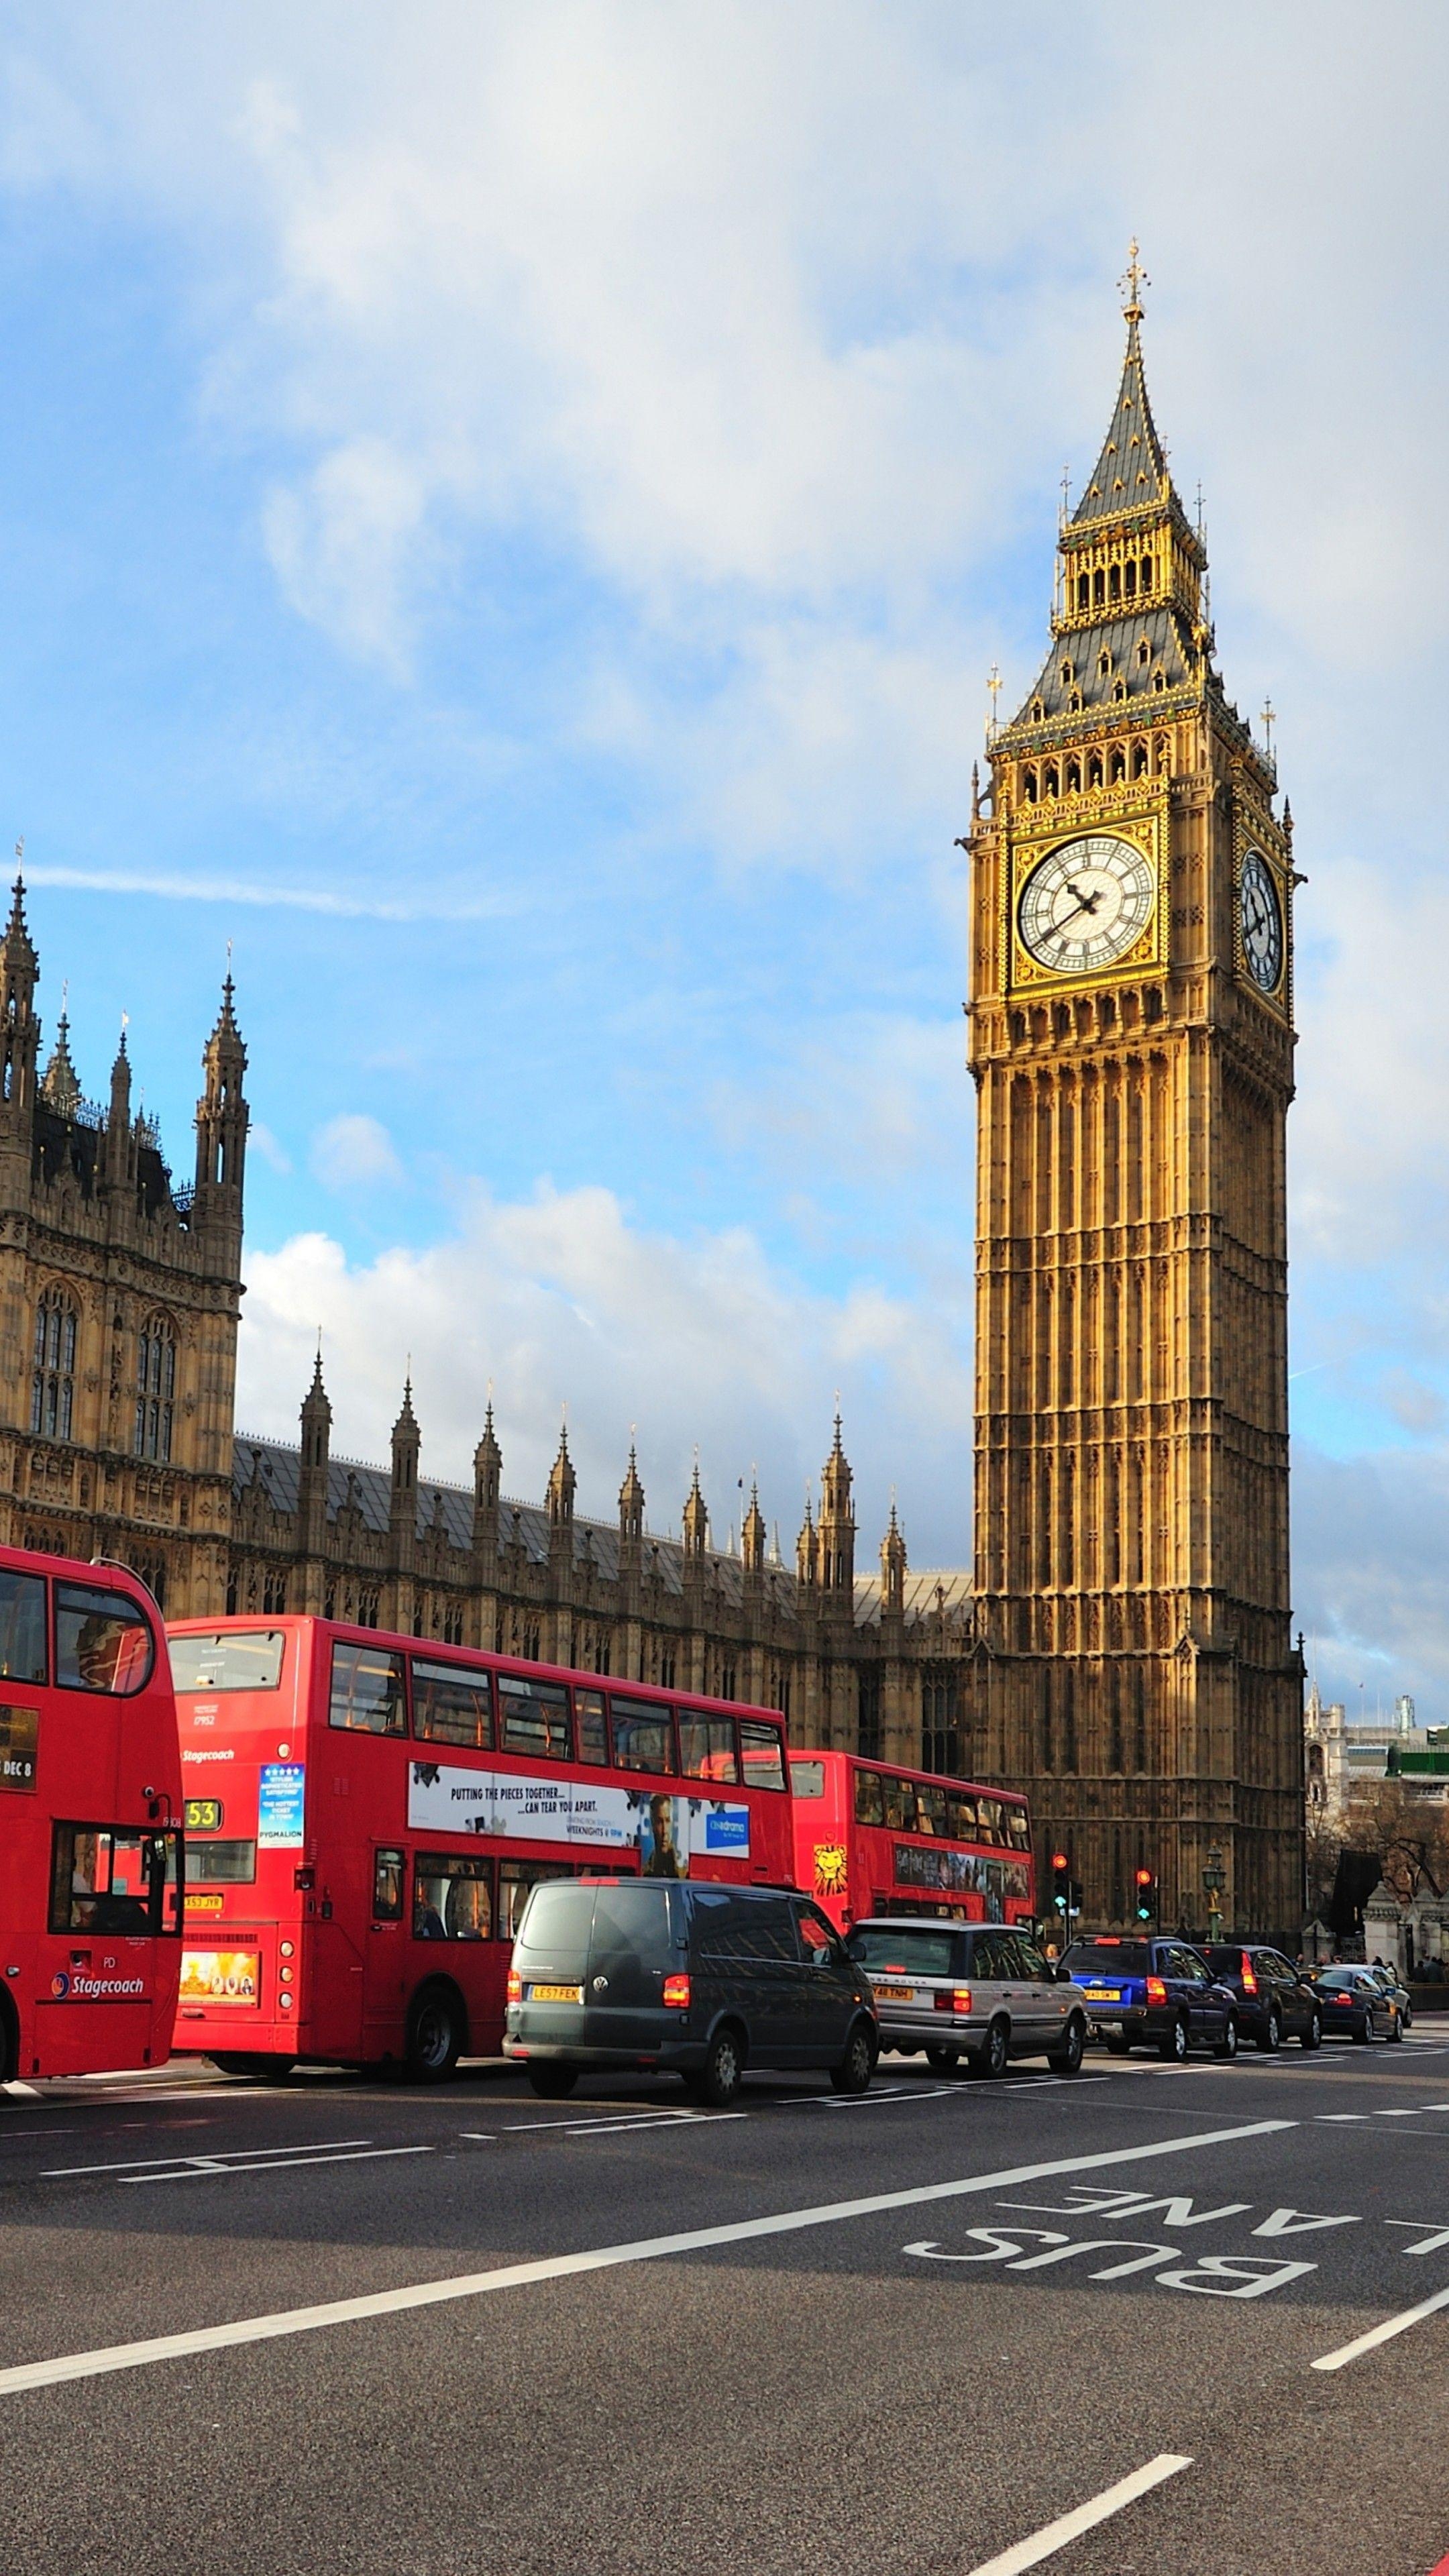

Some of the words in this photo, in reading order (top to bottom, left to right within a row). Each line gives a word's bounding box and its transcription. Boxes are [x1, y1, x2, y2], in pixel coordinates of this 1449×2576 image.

[182, 1749, 235, 1764] Stagecoach
[3, 1760, 22, 1776] DEC
[24, 1762, 32, 1777] 8
[451, 1788, 483, 1801] PUTTING
[485, 1788, 498, 1800] THE
[500, 1788, 523, 1800] PIECES
[188, 1802, 215, 1826] 53
[541, 1801, 557, 1813] TEAR
[559, 1801, 572, 1813] YOU
[184, 1897, 202, 1907] X53
[103, 1957, 115, 1968] PD
[72, 1976, 144, 1998] Stagecoach
[534, 1987, 557, 1998] LE57
[995, 2185, 1449, 2255] LANE
[902, 2227, 1319, 2298] BUS
